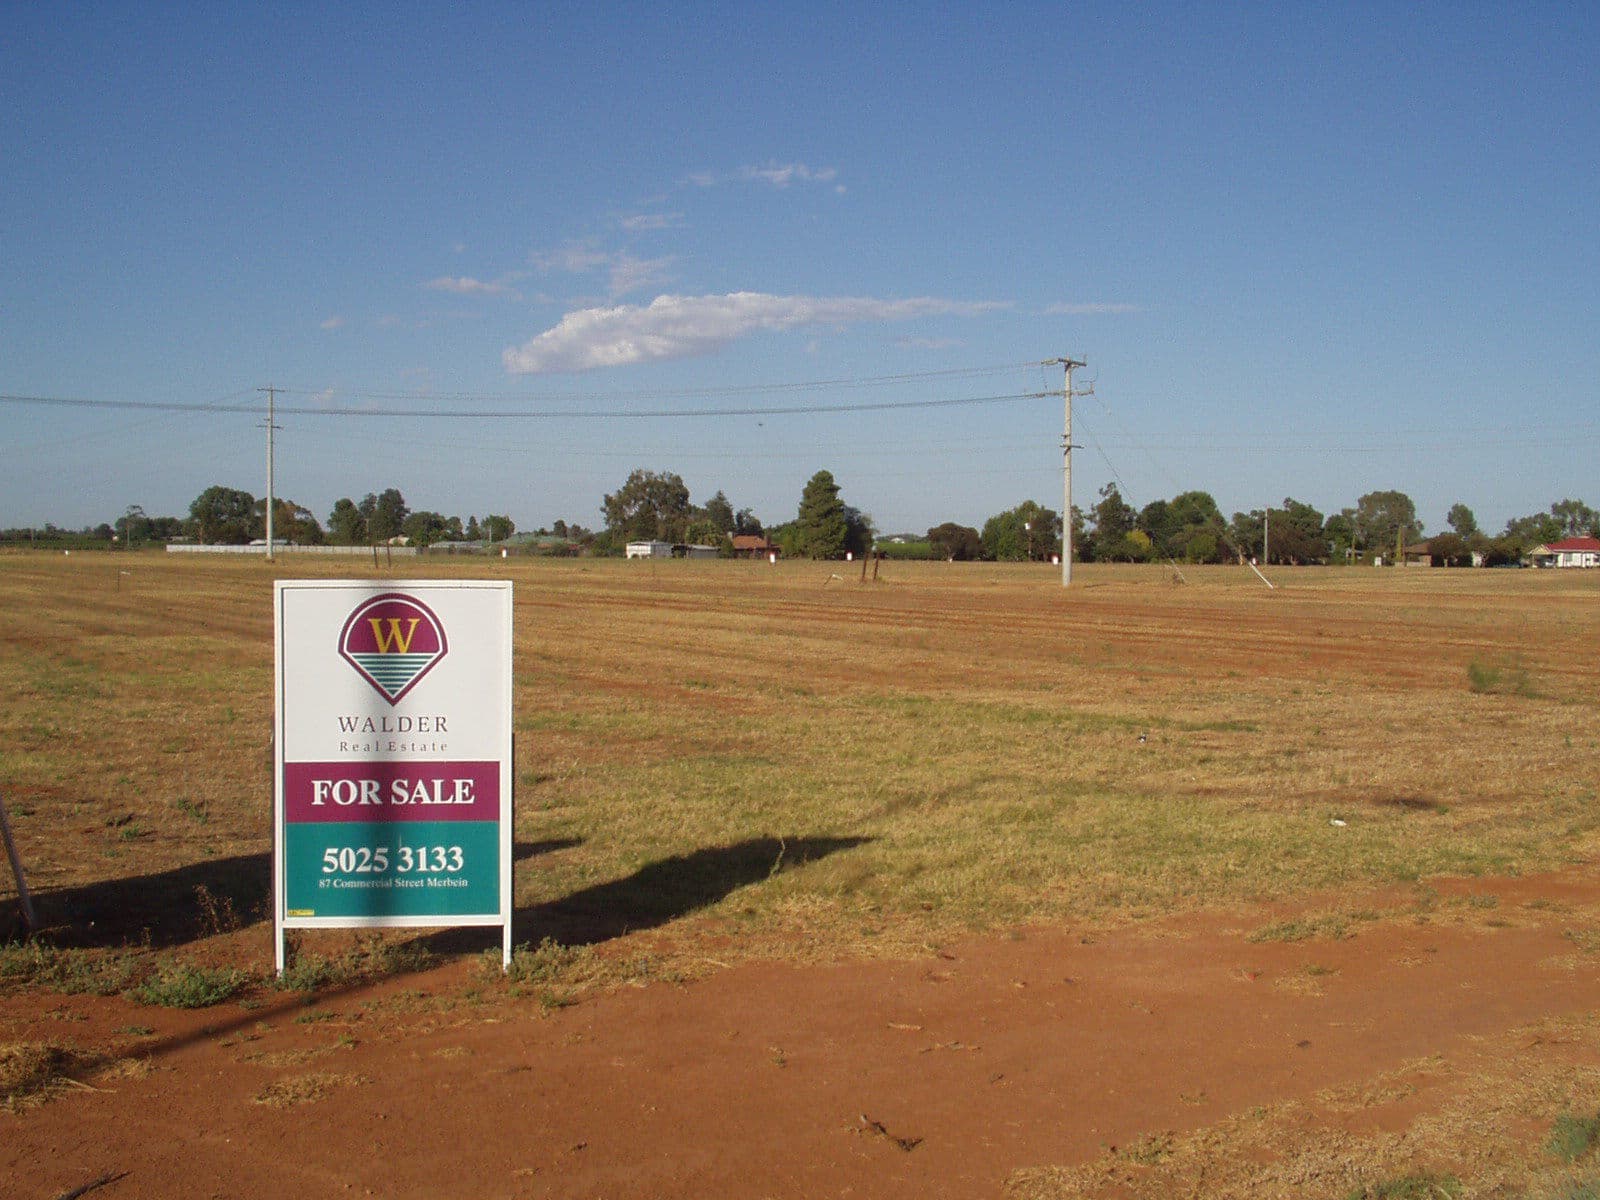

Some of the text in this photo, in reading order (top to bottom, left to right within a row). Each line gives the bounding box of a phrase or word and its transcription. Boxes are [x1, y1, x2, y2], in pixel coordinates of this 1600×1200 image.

[368, 618, 420, 653] W
[338, 716, 449, 733] WALDER
[339, 741, 448, 752] Real Estate
[311, 779, 475, 805] FOR SALE
[322, 846, 464, 873] 5025 3133
[318, 877, 468, 888] 87 Commercial Street Merbein
